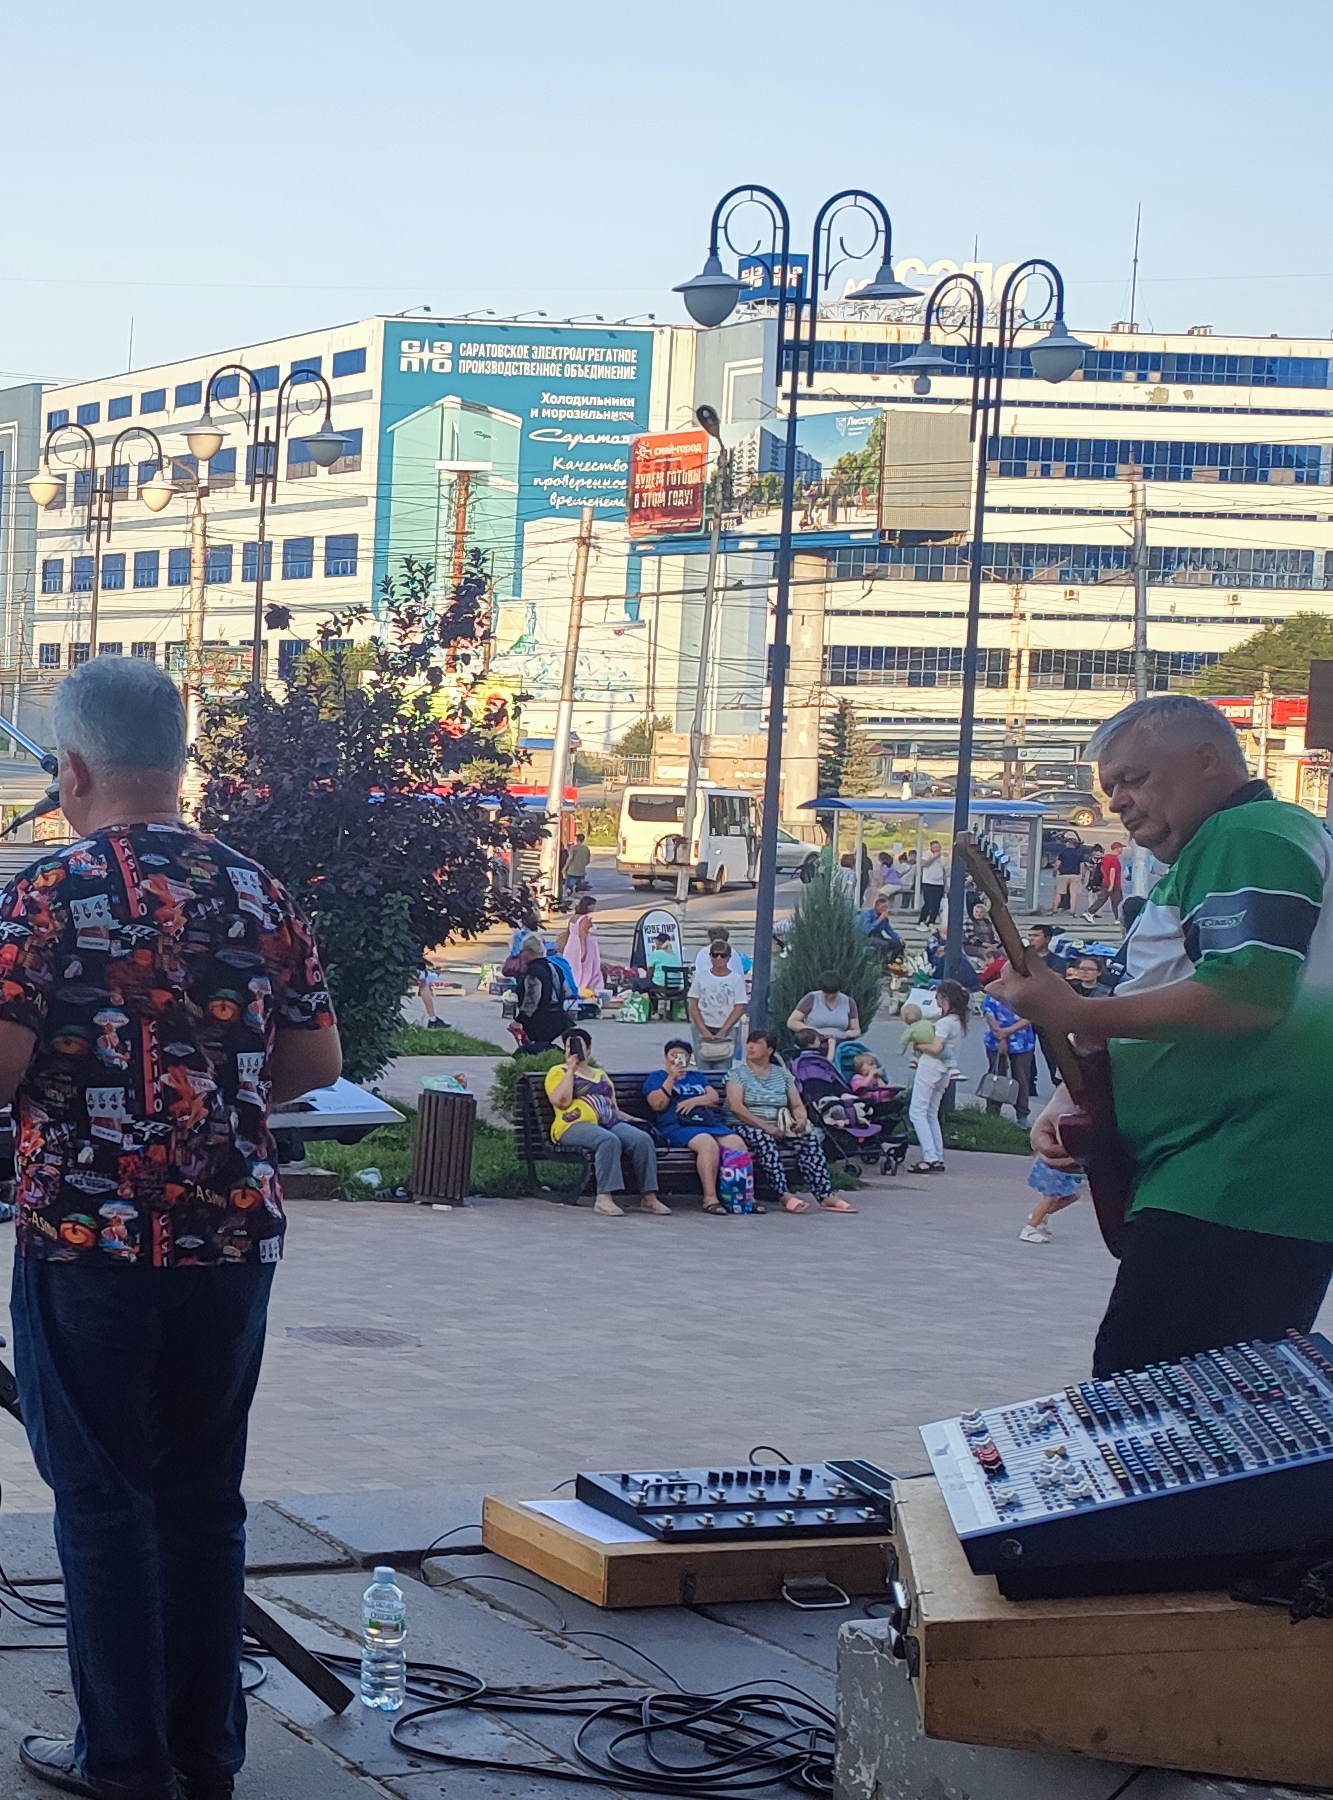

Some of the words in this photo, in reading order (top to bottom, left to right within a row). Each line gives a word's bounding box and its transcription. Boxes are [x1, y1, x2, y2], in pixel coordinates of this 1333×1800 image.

[459, 342, 530, 359] САРАТОВСКОЕ
[531, 345, 638, 363] ЭЛЕКТРОАГРЕГАТНОЕ
[458, 359, 562, 377] ПРОИЗВОДСТВЕННОЕ
[564, 363, 637, 380] ОБЪЕДИНЕНИЕ
[540, 392, 635, 407] Холодильники
[530, 408, 539, 418] и
[552, 456, 628, 472] Качество
